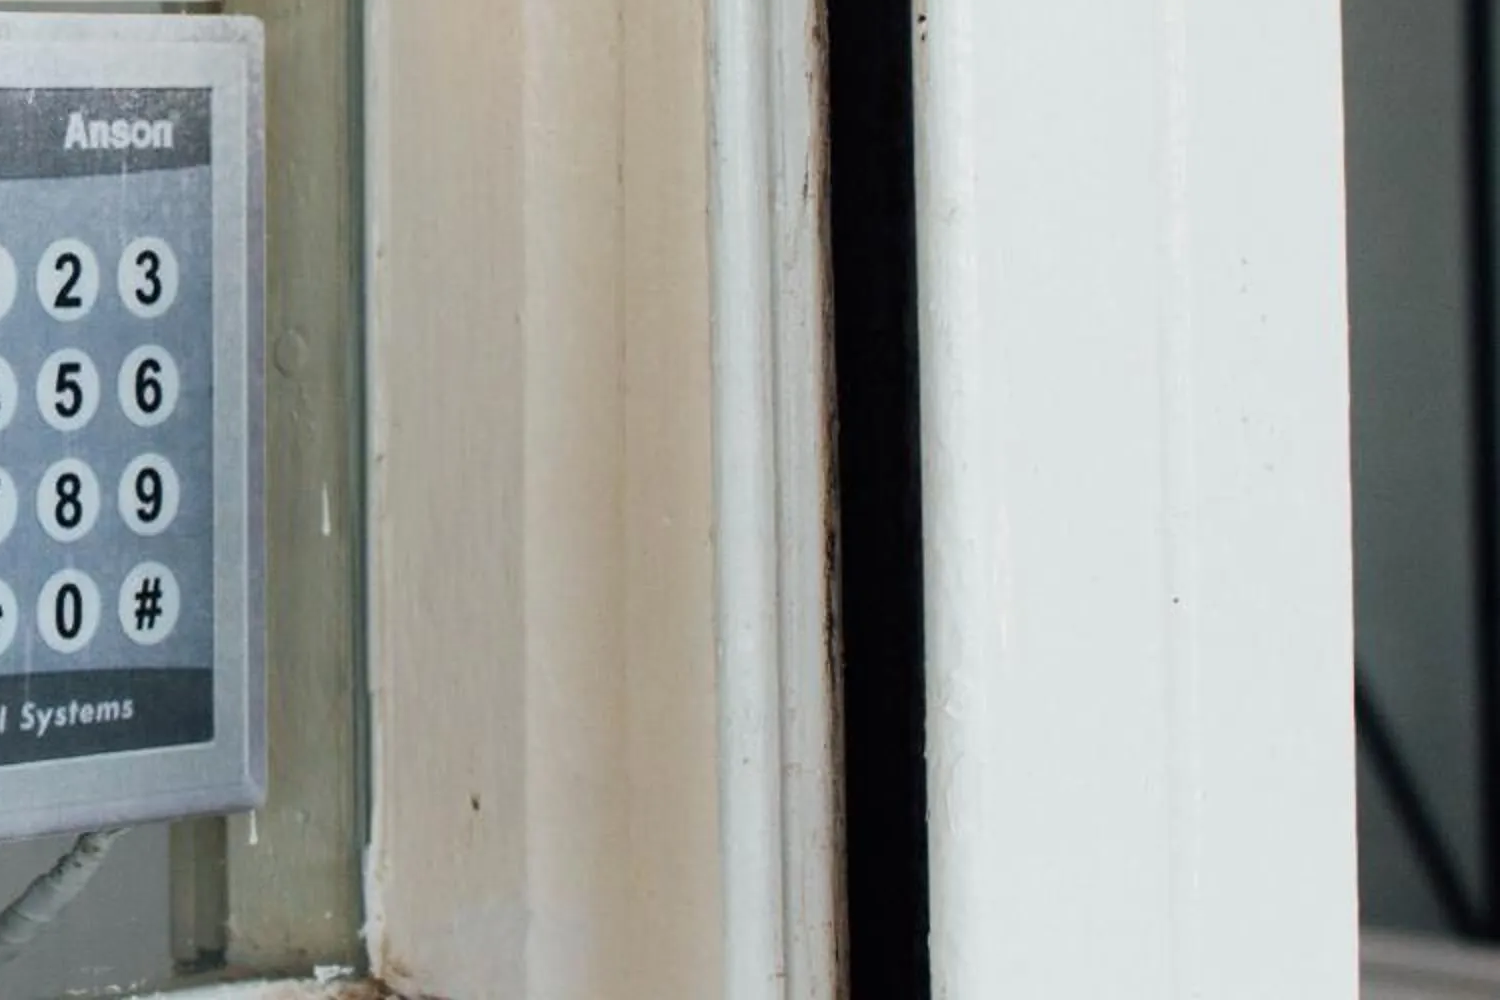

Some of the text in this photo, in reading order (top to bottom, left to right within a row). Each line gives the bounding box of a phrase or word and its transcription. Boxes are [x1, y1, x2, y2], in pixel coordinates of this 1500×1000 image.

[64, 110, 174, 149] Anson
[53, 252, 82, 309] 2
[135, 249, 162, 306] 3
[54, 362, 83, 418] 5
[135, 357, 163, 414] 6
[54, 472, 83, 529] 8
[135, 467, 163, 523] 9
[55, 582, 83, 640] 0
[19, 699, 135, 737] Systems
